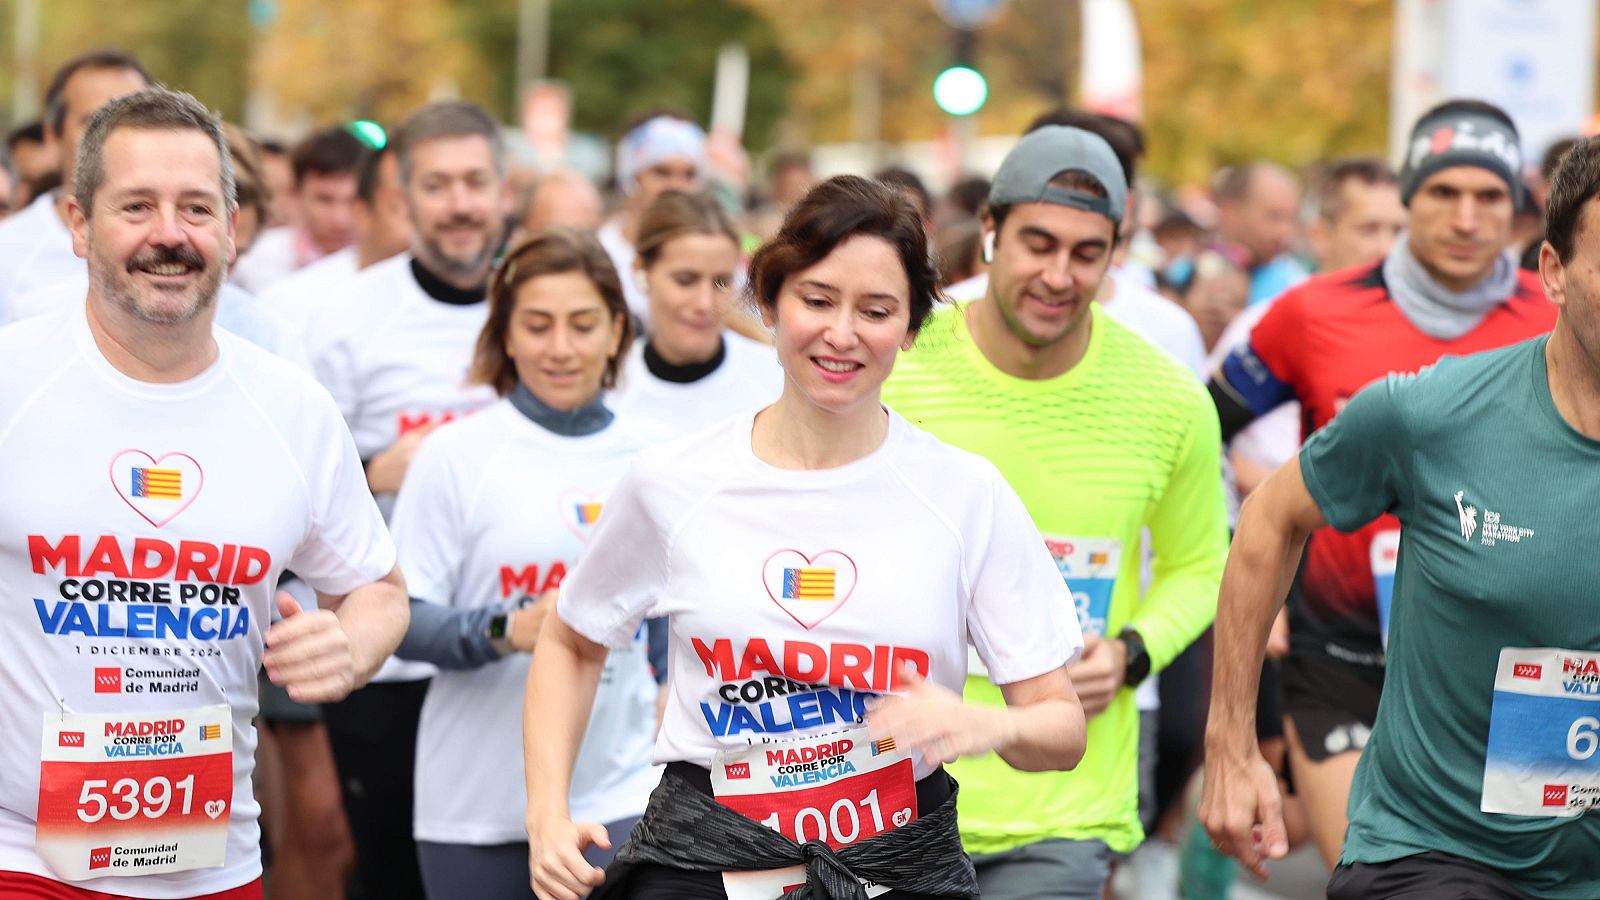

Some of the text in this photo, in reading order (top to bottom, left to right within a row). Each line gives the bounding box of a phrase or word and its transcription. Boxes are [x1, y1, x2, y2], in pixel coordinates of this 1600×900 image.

[28, 534, 272, 586] MADRID
[59, 578, 241, 606] CORRE POR
[33, 598, 249, 640] VALENCIA
[76, 645, 221, 657] 1 DICIEMBRE 2024
[125, 667, 200, 678] Comunidad
[691, 637, 930, 693] MADRID
[125, 681, 199, 693] de Madrid
[104, 719, 185, 736] MADRID
[113, 734, 177, 745] CORRE POR
[104, 742, 184, 758] VALENCIA
[766, 739, 854, 767] MADRID
[778, 755, 845, 775] CORRE POR
[770, 760, 856, 788] VALENCIA
[76, 773, 195, 823] 5391
[898, 813, 906, 823] 5K
[114, 842, 178, 855] Comunidad
[113, 854, 177, 867] de Madrid
